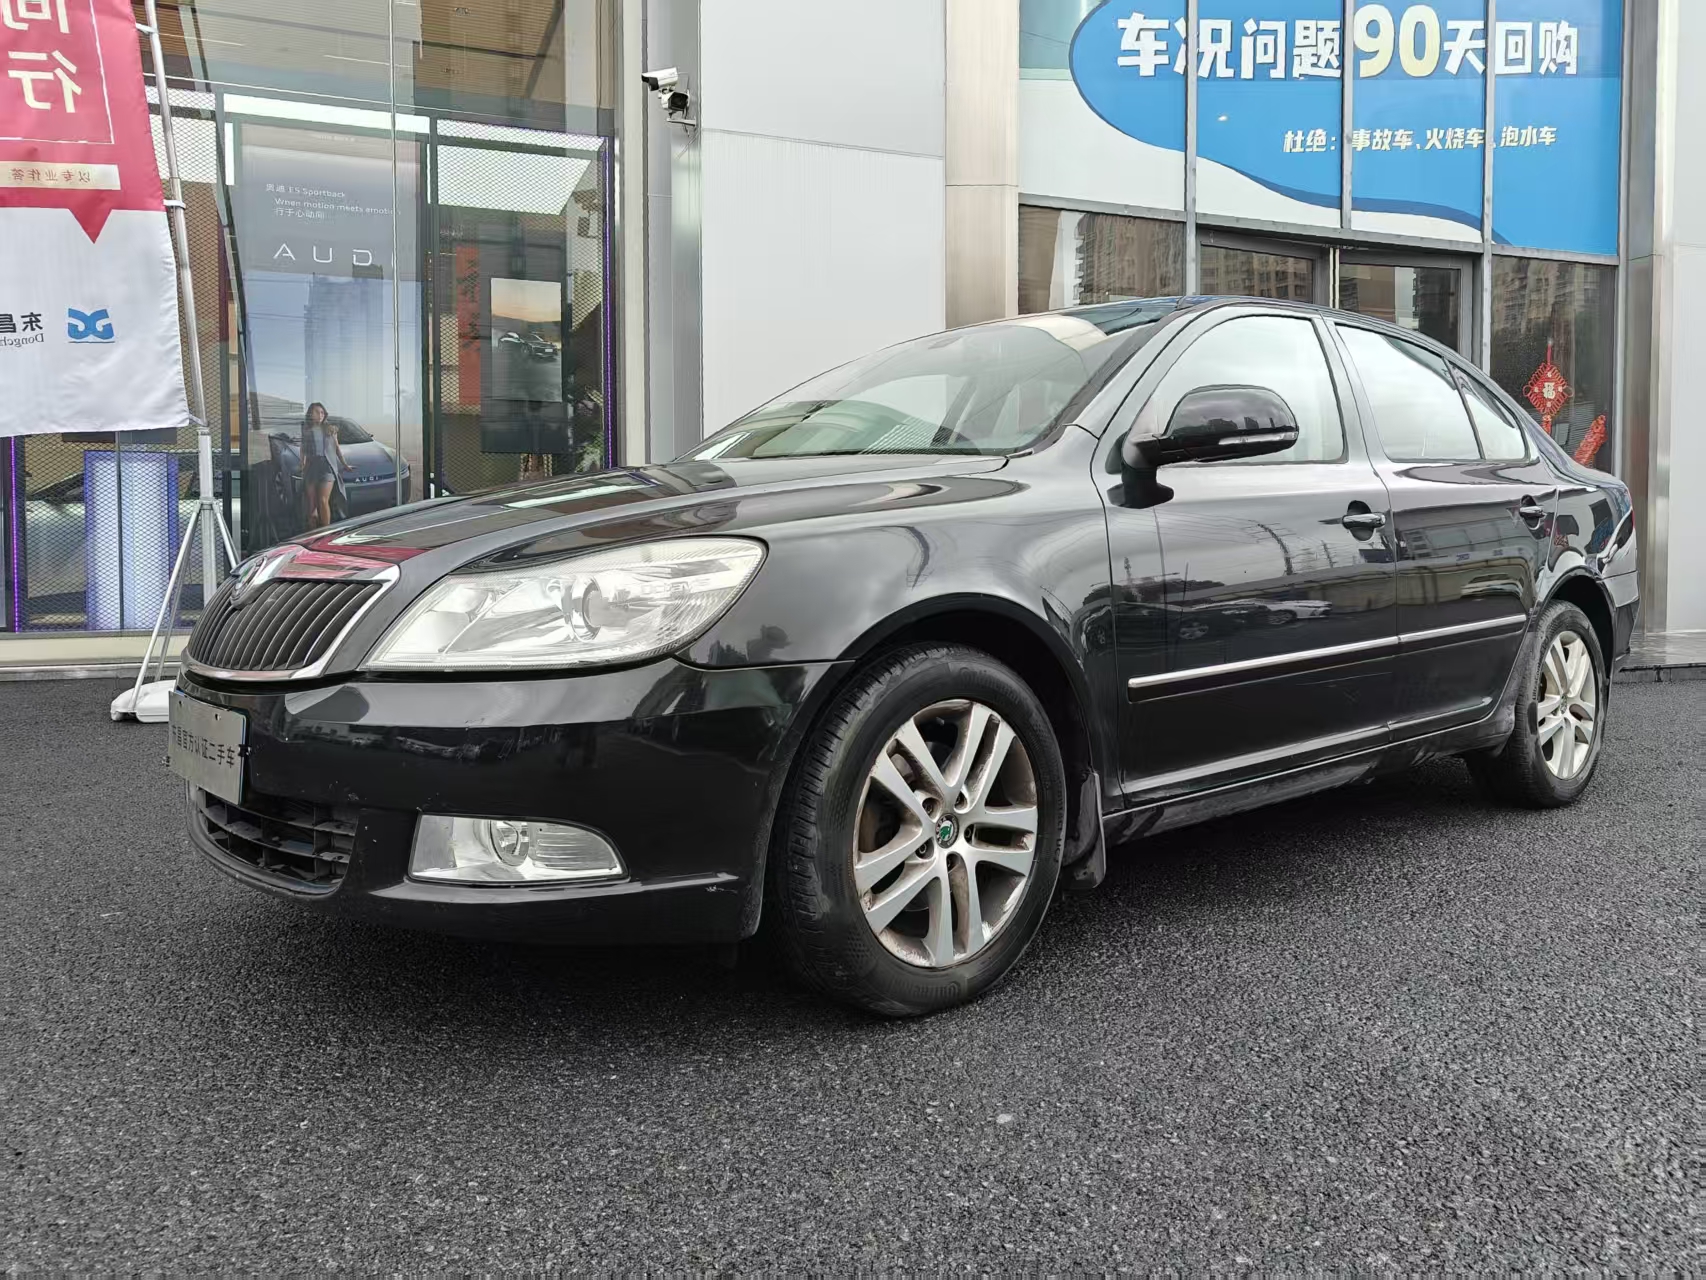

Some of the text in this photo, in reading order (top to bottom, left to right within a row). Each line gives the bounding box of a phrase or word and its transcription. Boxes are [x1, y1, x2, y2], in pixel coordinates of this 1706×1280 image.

[1117, 3, 1578, 80] 车况问题90天回购
[266, 183, 286, 193] 奥迪
[303, 188, 346, 198] Sportback
[274, 197, 301, 207] When
[303, 201, 335, 210] motion
